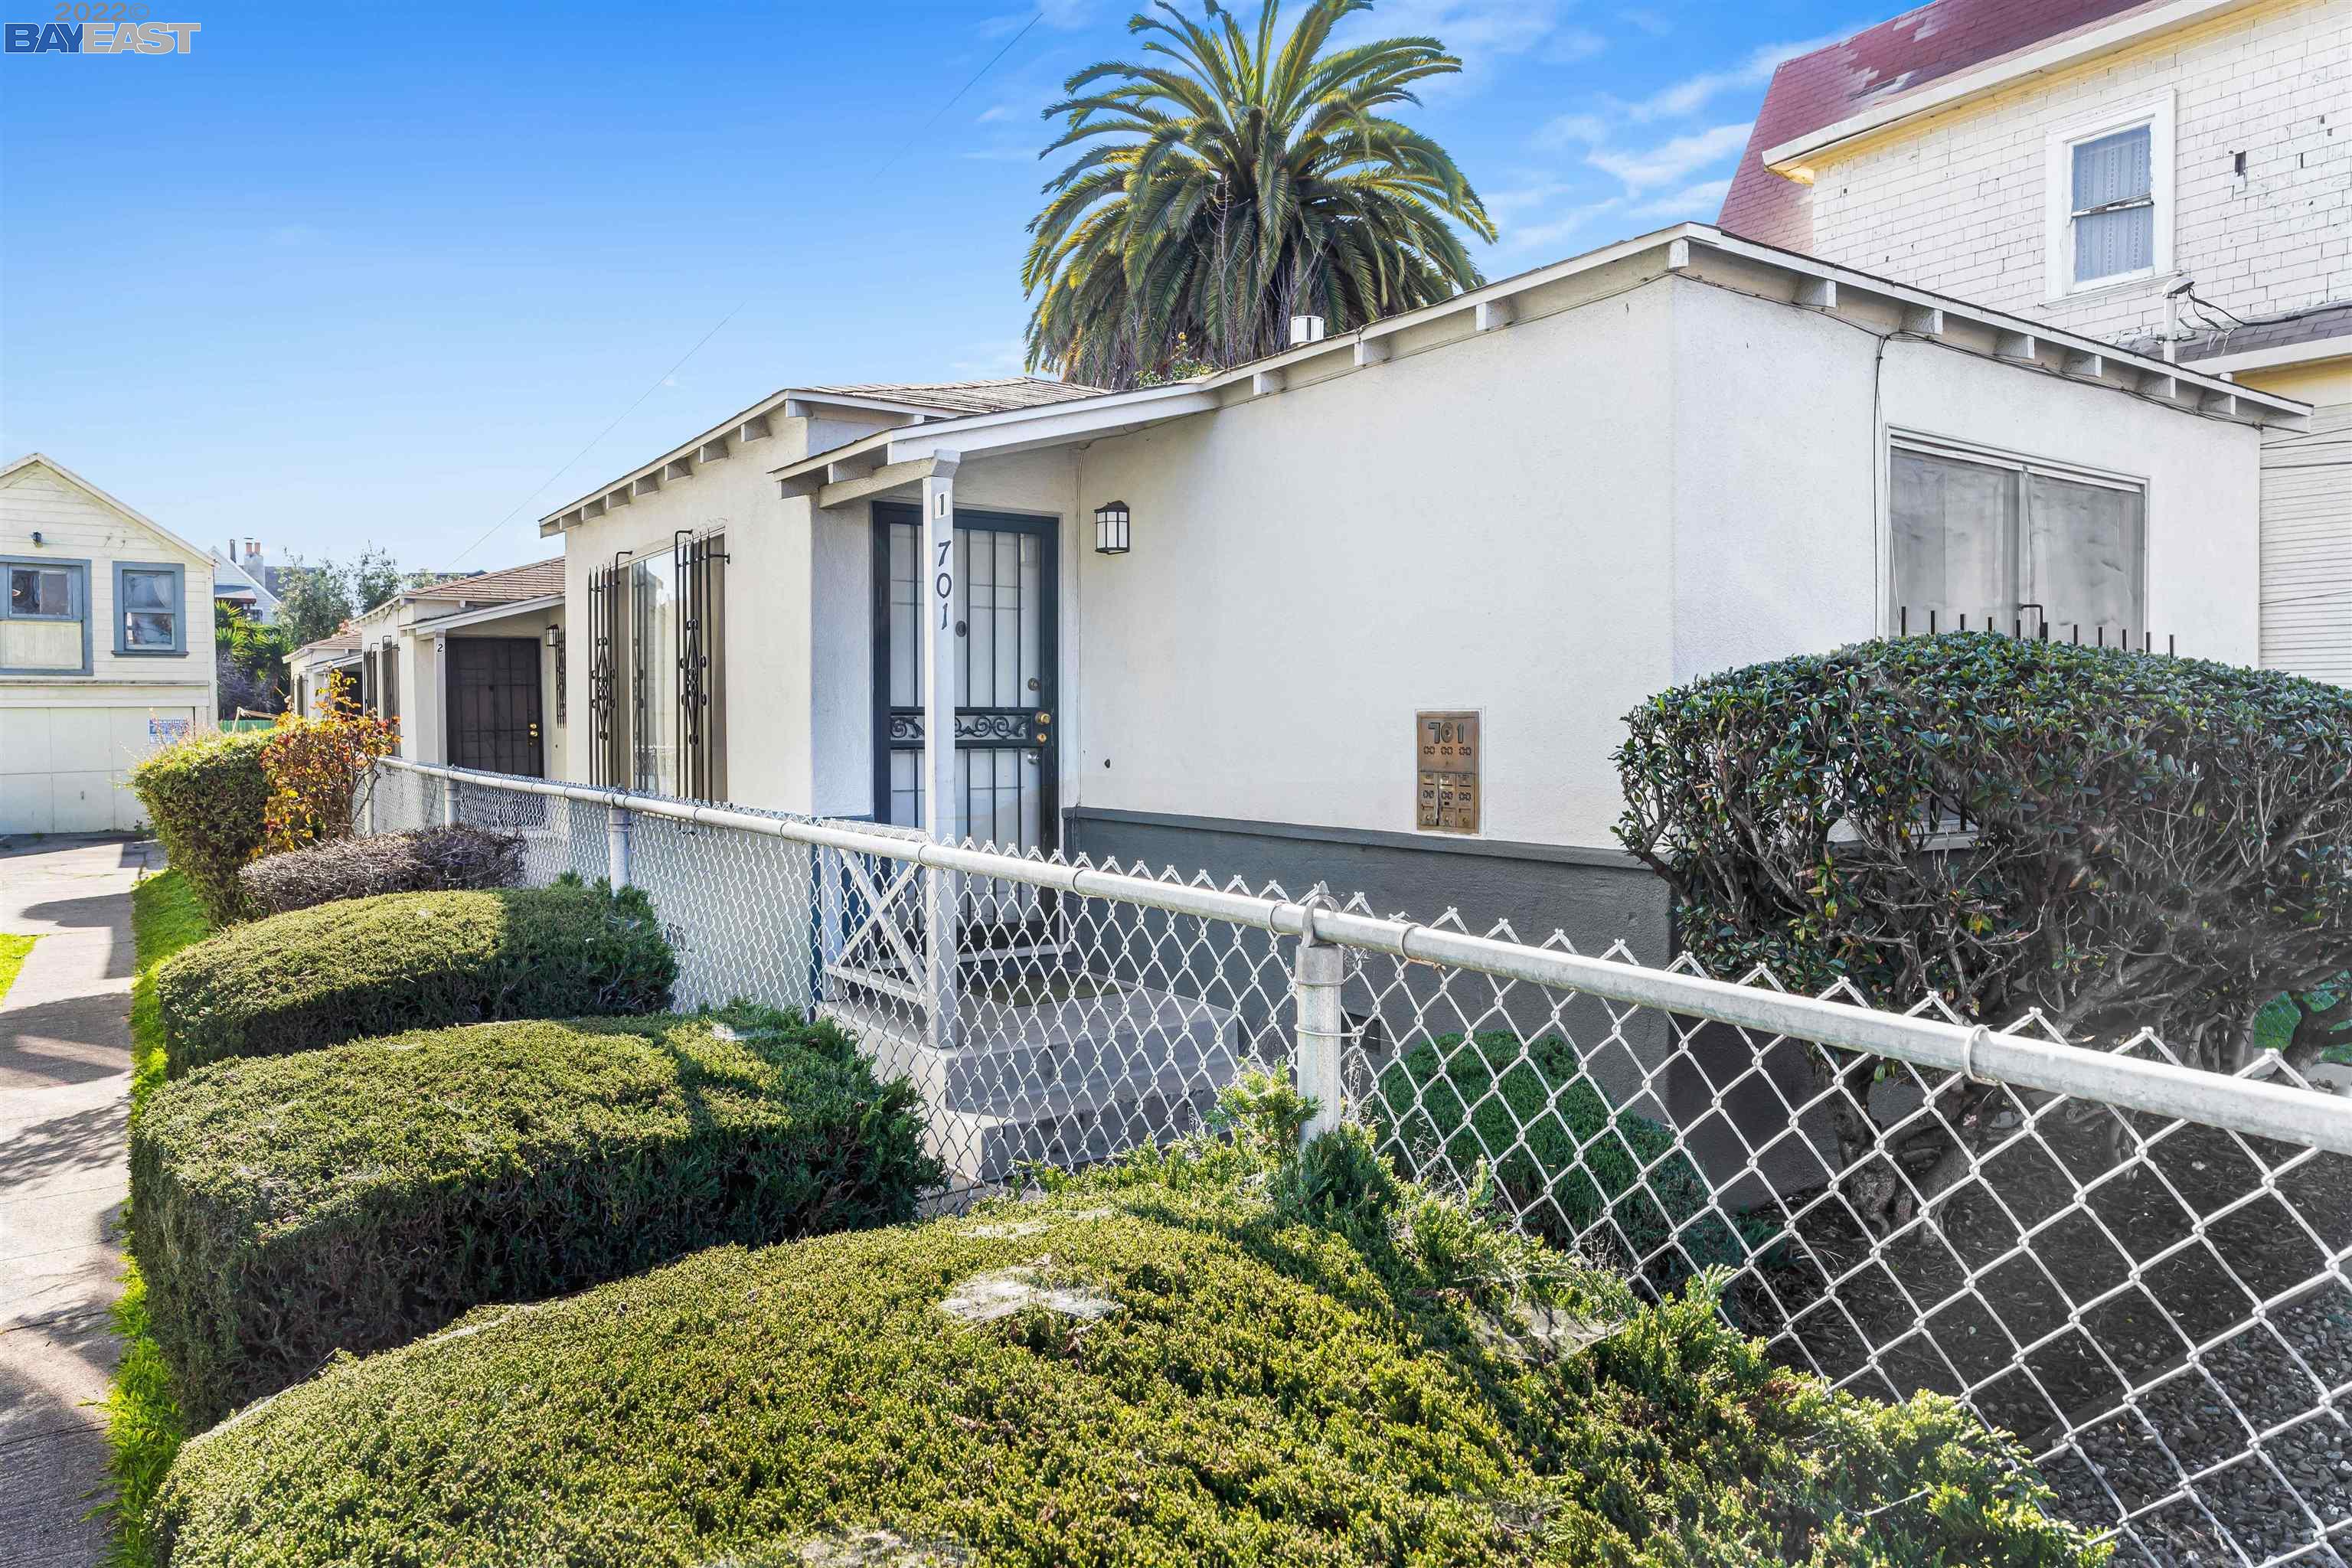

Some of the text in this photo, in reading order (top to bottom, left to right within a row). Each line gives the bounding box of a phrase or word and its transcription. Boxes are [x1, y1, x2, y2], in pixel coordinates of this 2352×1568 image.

[936, 540, 952, 630] 701
[437, 643, 443, 652] 2
[1428, 722, 1465, 744] 701
